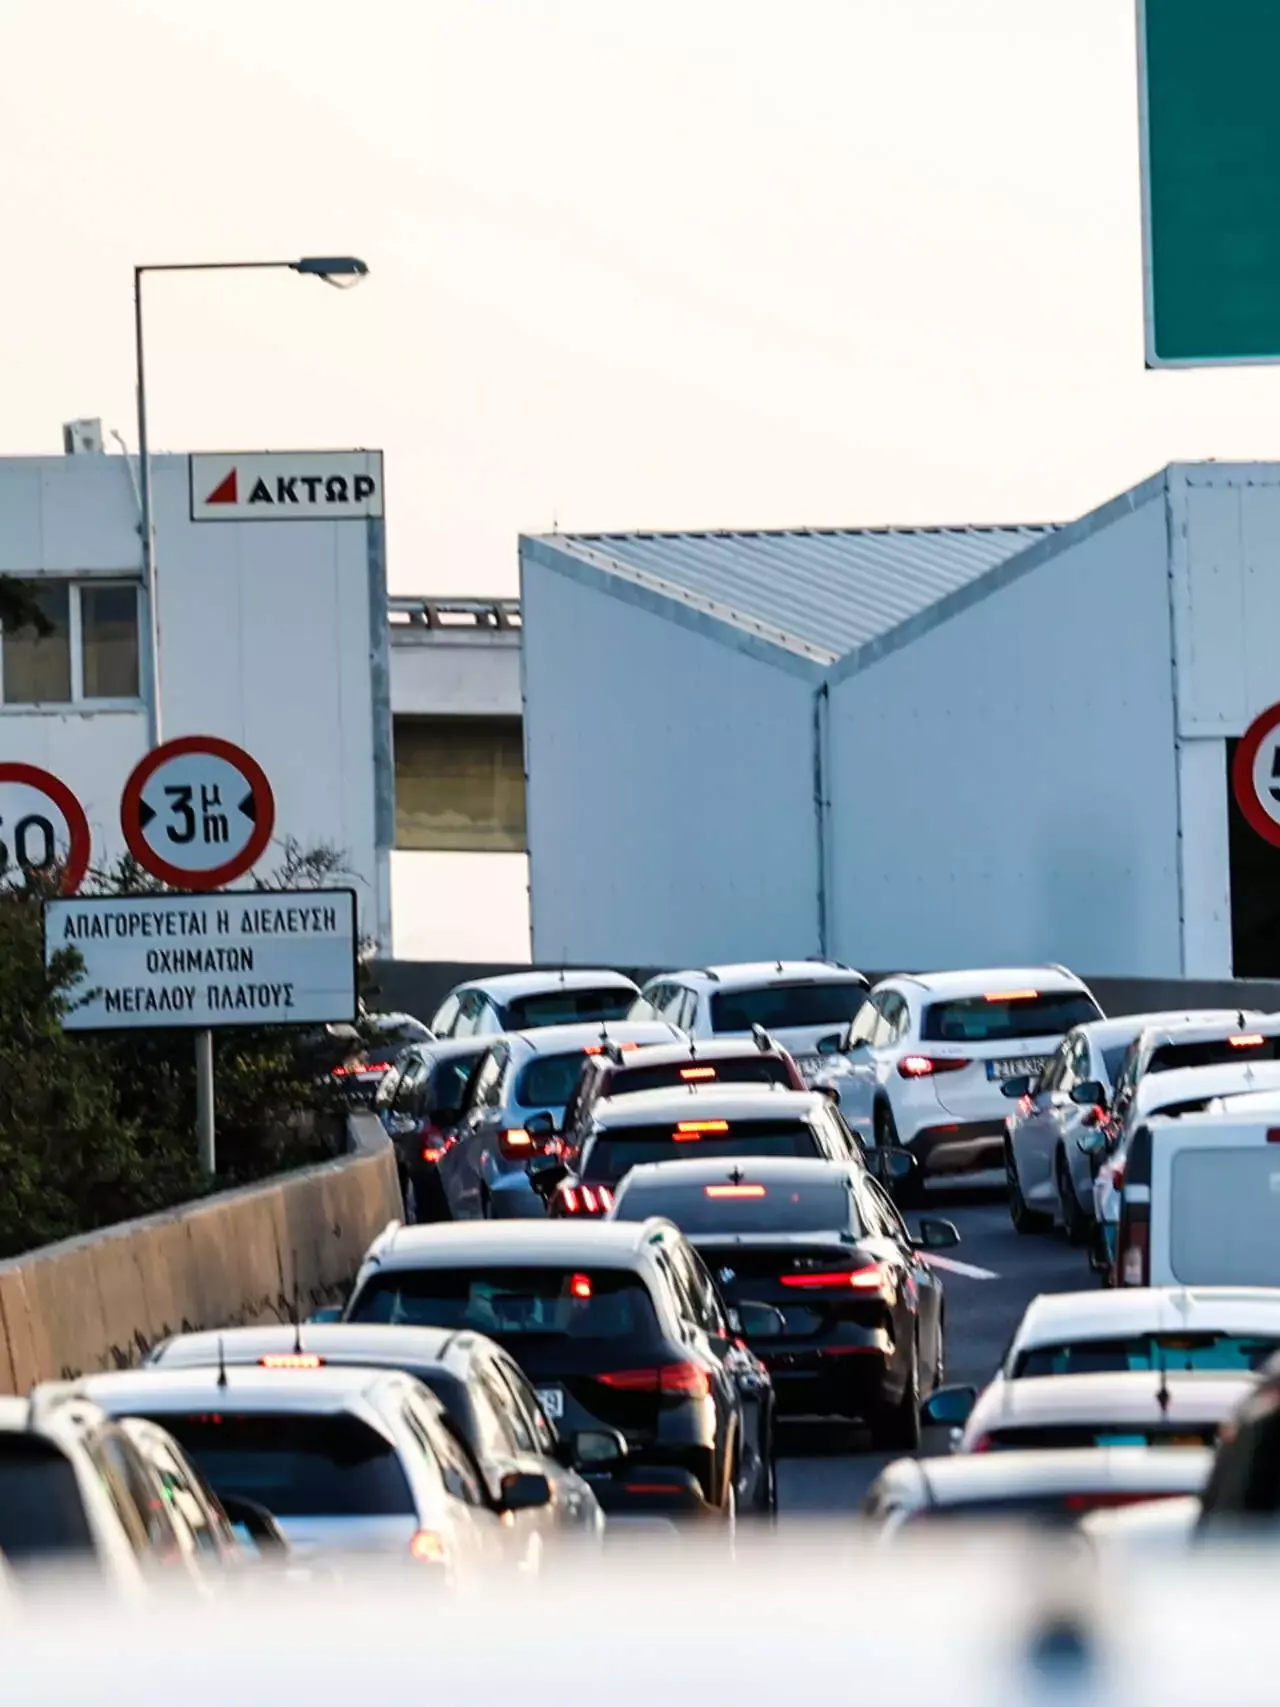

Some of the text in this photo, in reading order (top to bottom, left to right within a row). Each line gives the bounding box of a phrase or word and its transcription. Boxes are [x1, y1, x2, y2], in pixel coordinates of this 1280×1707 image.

[248, 474, 376, 505] ΑΚΤΩΡ
[63, 907, 337, 940] ΑΠΑΓΟΡΕΥΕΤΑΙ Η ΔΙΕΛΕΥΣΗ
[146, 947, 254, 974] ΟΧΗΜΑΤΩΝ
[104, 982, 295, 1013] ΜΕΓΑΛΟΥ ΠΛΑΤΟΥΣ
